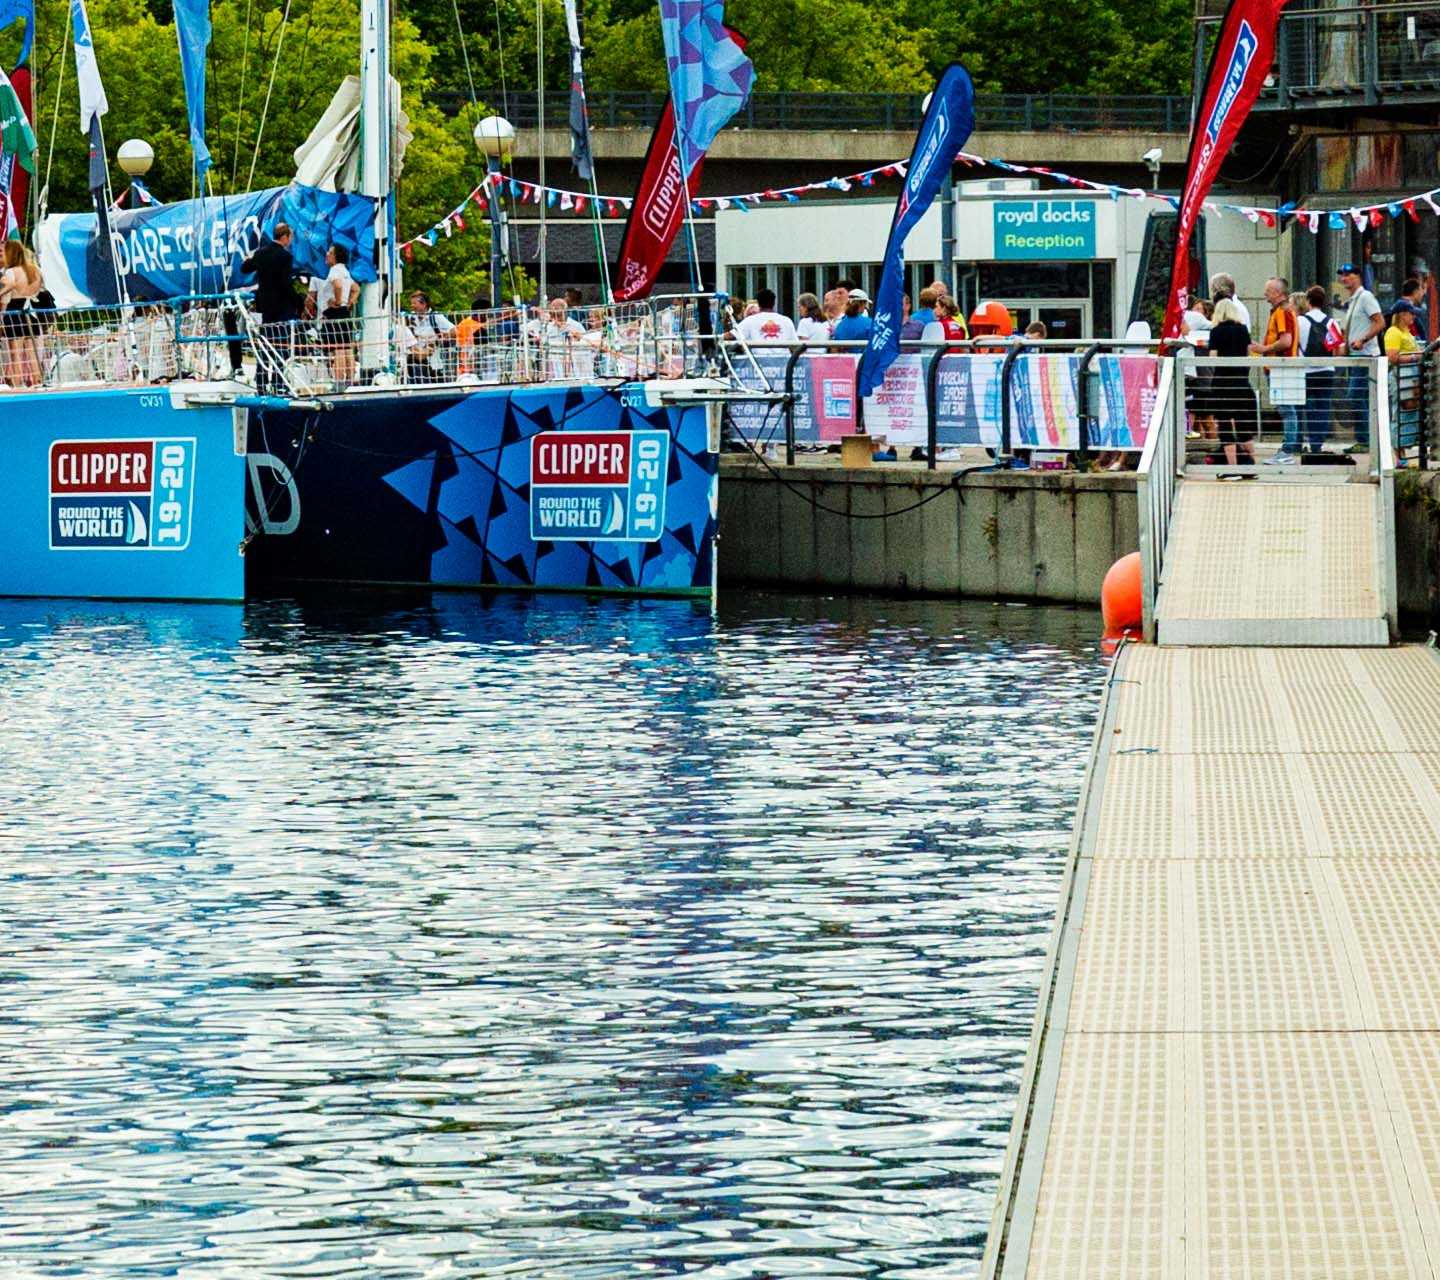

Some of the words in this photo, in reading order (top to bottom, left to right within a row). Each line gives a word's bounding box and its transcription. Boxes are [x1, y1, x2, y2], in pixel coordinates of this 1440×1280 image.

[648, 153, 683, 229] CLIPPER
[997, 200, 1039, 227] royal
[1042, 201, 1091, 223] docks
[109, 228, 175, 276] DARE
[1004, 234, 1086, 251] Reception
[139, 395, 164, 408] CV31
[57, 452, 148, 486] CLIPPER
[537, 442, 626, 476] CLIPPER
[158, 444, 186, 544] 19-20
[632, 438, 662, 531] 19-20
[58, 506, 97, 520] ROUND
[98, 506, 125, 520] THE
[538, 497, 578, 510] ROUND
[579, 497, 603, 510] THE
[58, 518, 124, 538] WORLD
[538, 508, 603, 528] WORLD
